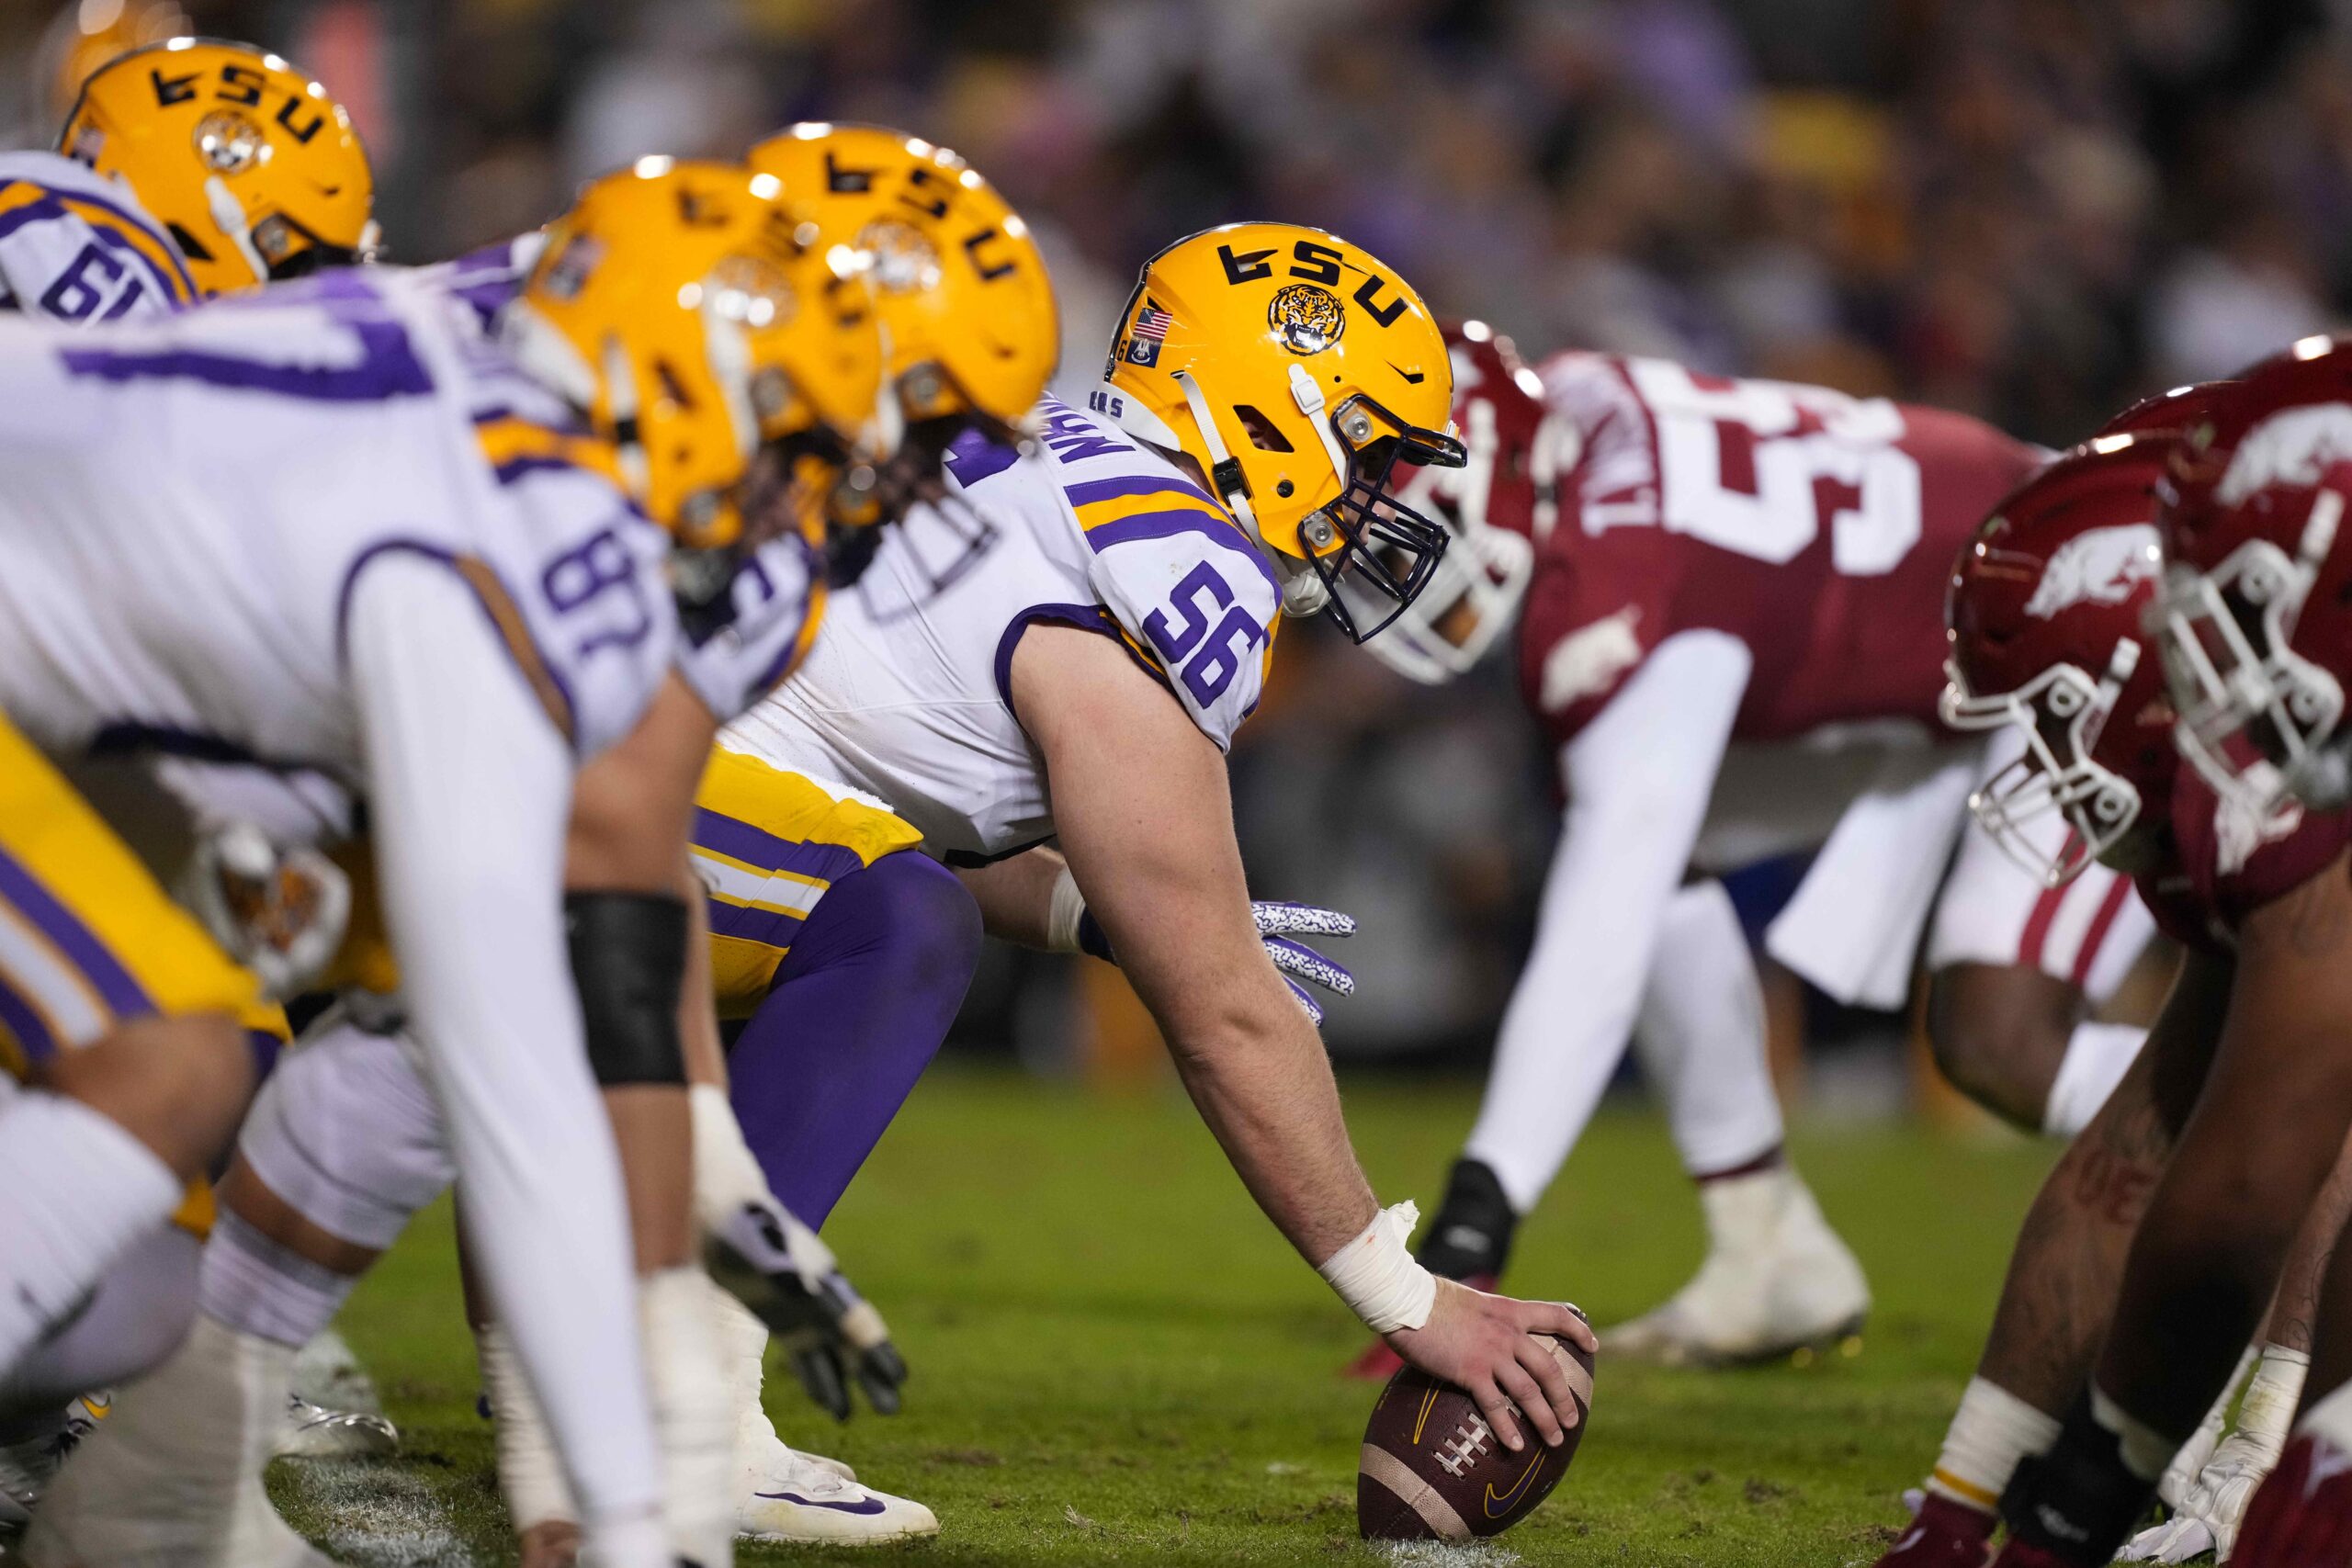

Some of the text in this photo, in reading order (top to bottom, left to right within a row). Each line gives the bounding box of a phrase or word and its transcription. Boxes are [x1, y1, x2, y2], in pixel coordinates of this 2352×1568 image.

[150, 65, 324, 144] LSU
[823, 150, 1017, 283] LSU
[1217, 241, 1408, 328] LSU
[1142, 559, 1263, 710] 56
